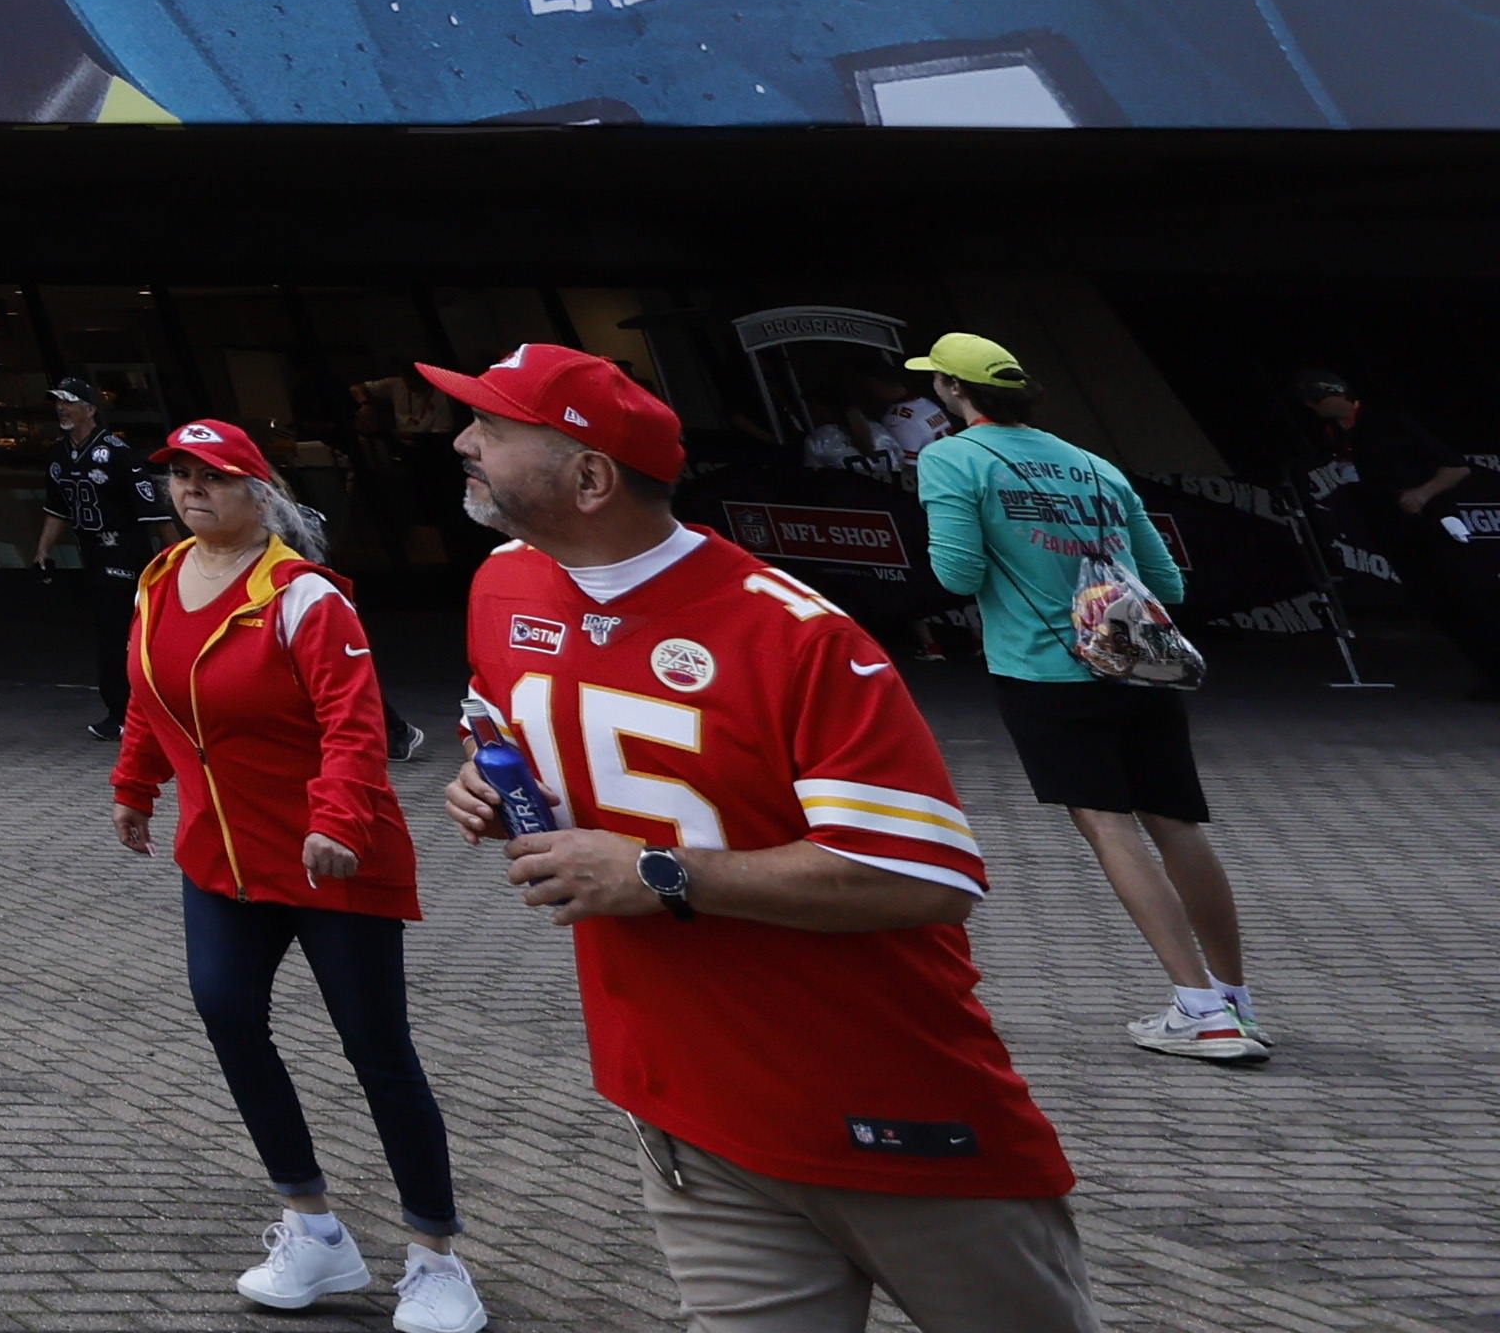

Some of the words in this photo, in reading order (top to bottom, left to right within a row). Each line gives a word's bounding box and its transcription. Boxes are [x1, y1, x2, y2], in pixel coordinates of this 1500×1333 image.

[762, 319, 862, 337] PROGRAMS
[1069, 466, 1094, 484] OF
[779, 522, 826, 544] NFL
[828, 526, 892, 548] SHOP
[873, 566, 907, 582] VISA
[531, 627, 561, 646] STM
[510, 671, 728, 850] 15
[509, 786, 541, 834] TRA
